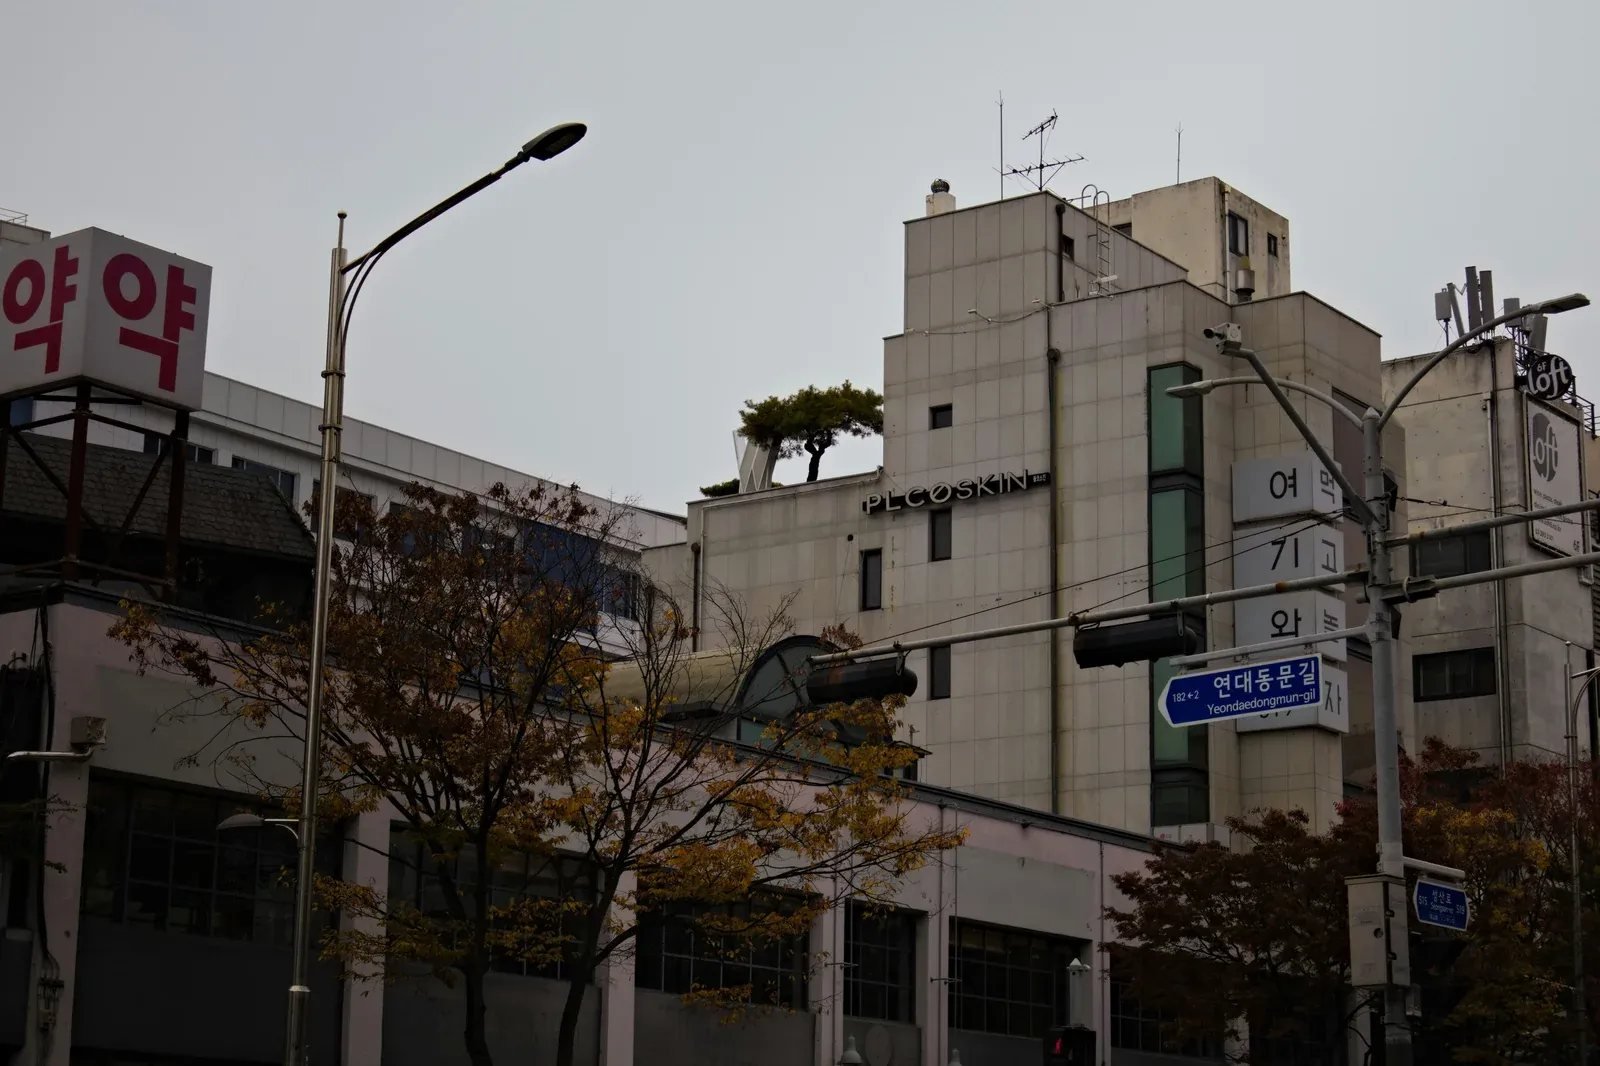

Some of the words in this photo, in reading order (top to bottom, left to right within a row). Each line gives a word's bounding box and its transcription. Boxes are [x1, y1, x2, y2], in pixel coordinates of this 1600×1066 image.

[3, 245, 79, 374] 약
[103, 253, 197, 393] 약
[1528, 356, 1568, 399] loft
[1172, 691, 1187, 703] 182
[1213, 660, 1316, 699] 연대동문길
[1207, 688, 1316, 716] Yeondaedongmun-gil
